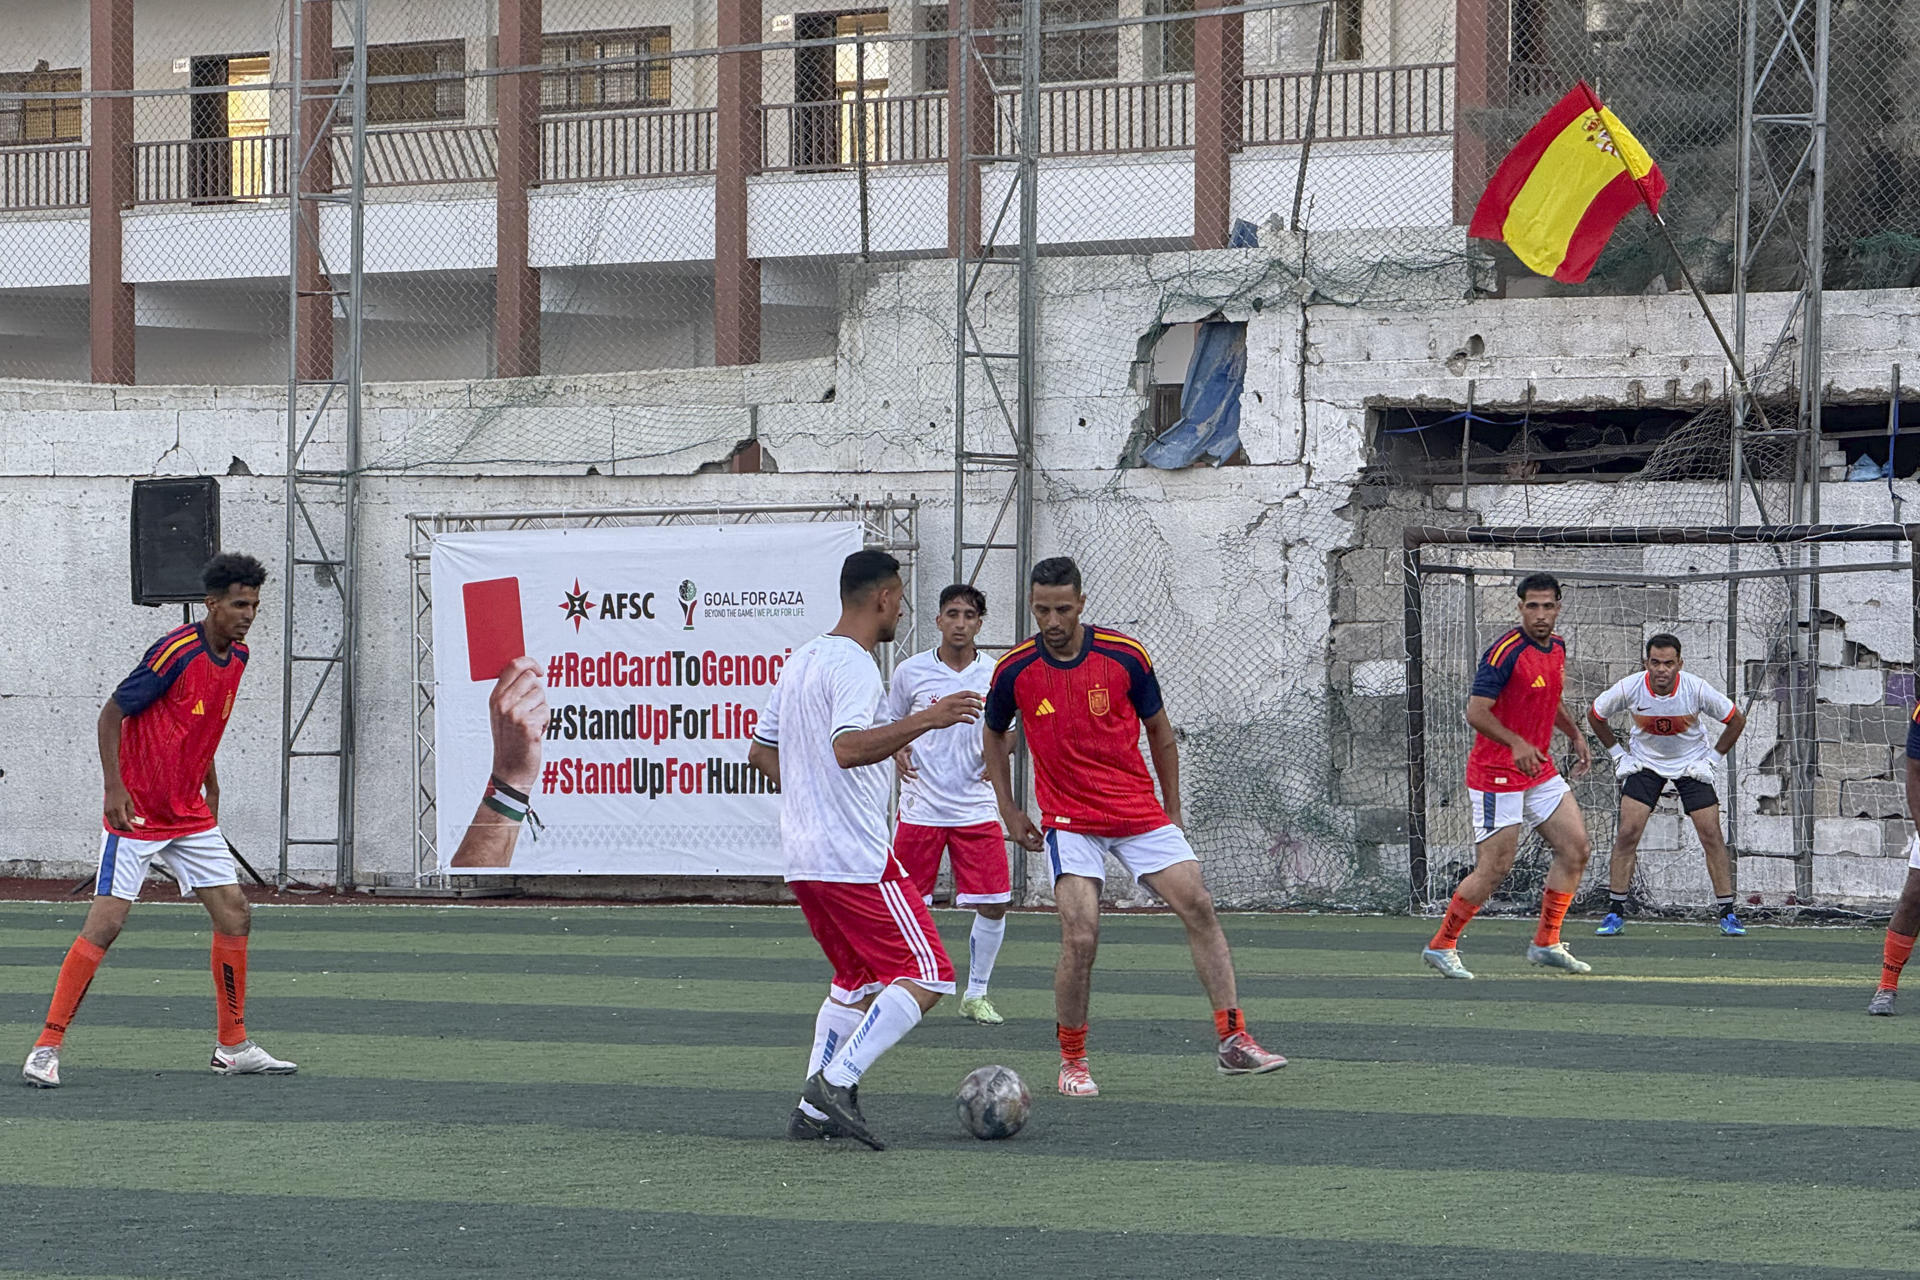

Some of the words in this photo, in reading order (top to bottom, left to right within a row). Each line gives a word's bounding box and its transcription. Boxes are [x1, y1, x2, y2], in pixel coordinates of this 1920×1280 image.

[599, 592, 655, 620] AFSC
[704, 592, 740, 606] GOAL
[741, 591, 767, 606] FOR
[769, 591, 804, 606] GAZA
[704, 609, 726, 618] BEYOND
[727, 609, 737, 618] THE
[737, 608, 754, 617] GAME
[756, 608, 766, 617] WE
[766, 608, 780, 617] PLAY
[780, 607, 792, 617] FOR
[792, 607, 805, 617] LIFE
[546, 702, 759, 745] #StandUpForLife
